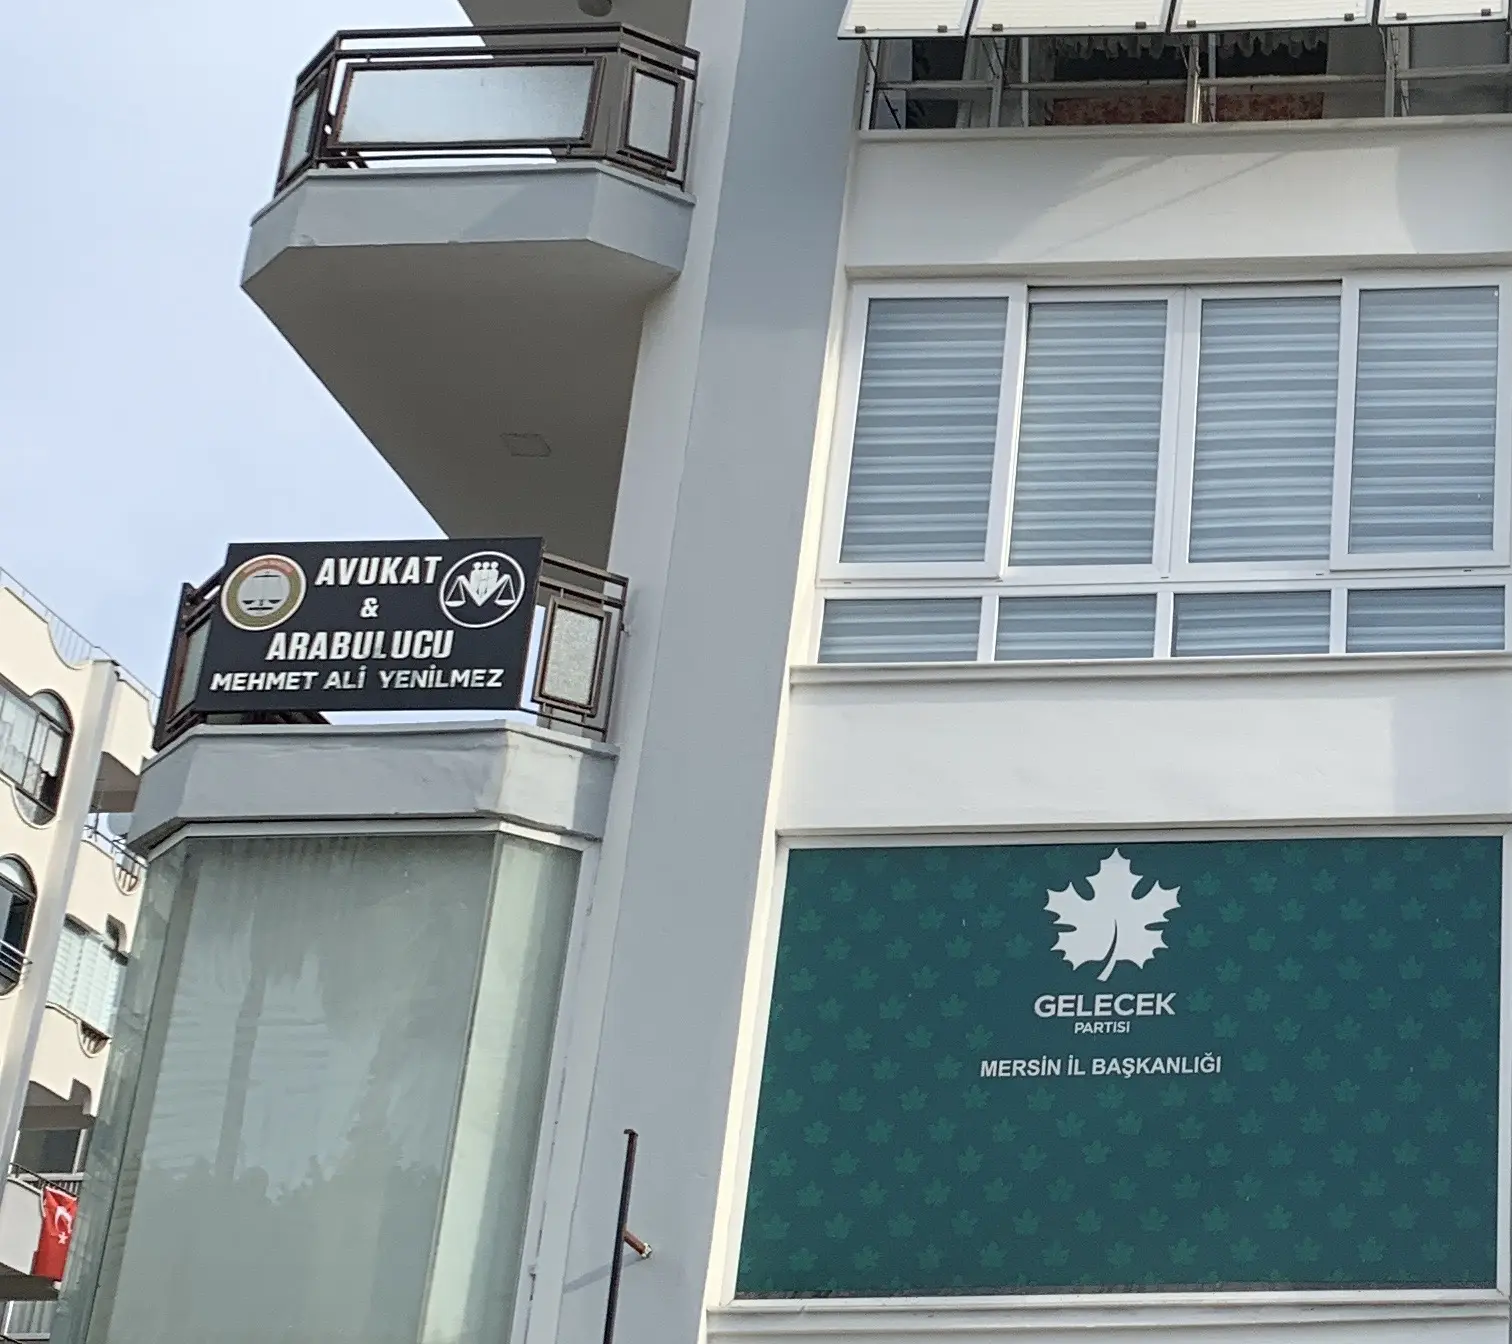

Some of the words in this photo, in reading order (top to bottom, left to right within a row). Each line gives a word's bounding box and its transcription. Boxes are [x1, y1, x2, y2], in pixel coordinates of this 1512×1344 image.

[314, 556, 443, 586] AVUKAT
[360, 598, 379, 618] &
[265, 630, 454, 661] ARABULUCU
[210, 671, 319, 691] MEHMET
[322, 665, 367, 689] ALİ
[379, 664, 504, 688] YENİLMEZ
[1034, 993, 1176, 1018] GELECEK
[980, 1056, 1061, 1077] MERSİN
[1068, 1055, 1086, 1076] İL
[1091, 1053, 1222, 1079] BAŞKANLIĞI
